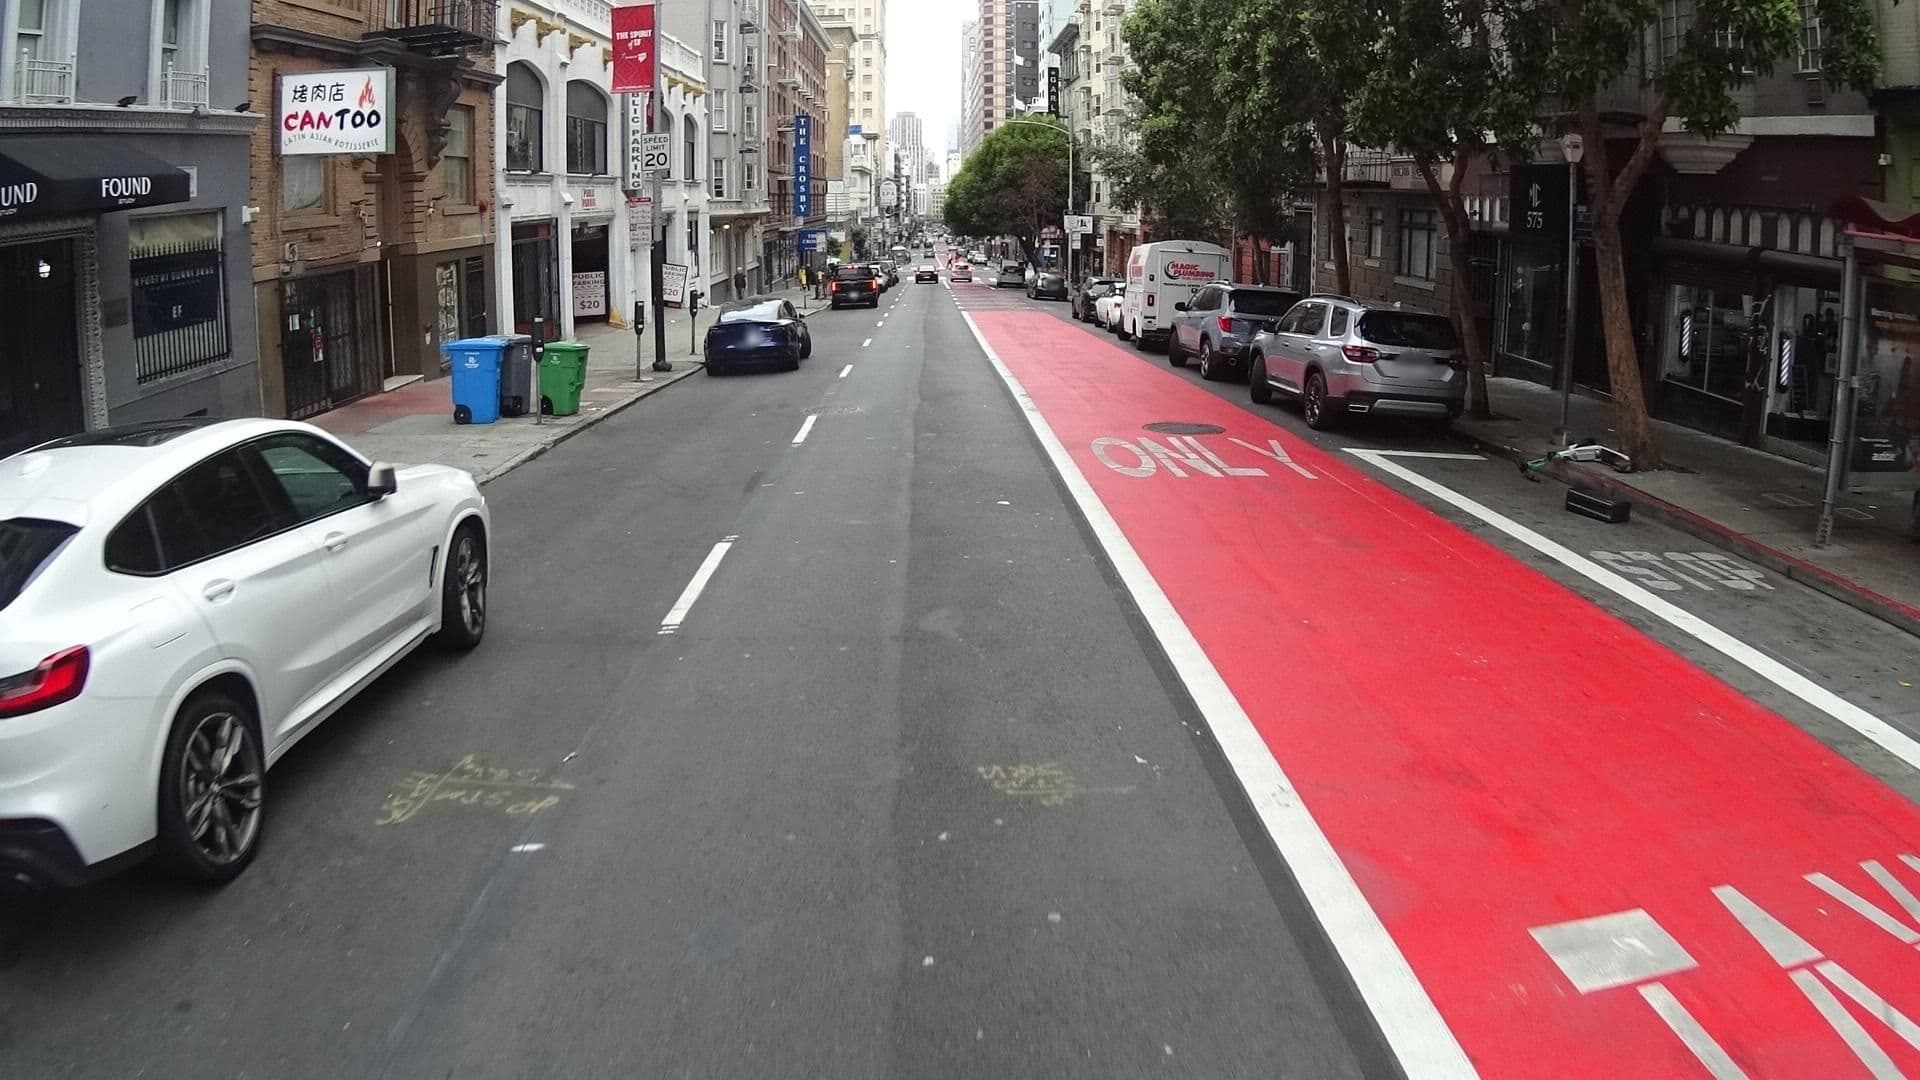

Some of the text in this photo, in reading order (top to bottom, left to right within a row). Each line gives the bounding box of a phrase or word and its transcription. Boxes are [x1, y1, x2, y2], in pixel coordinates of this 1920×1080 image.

[616, 29, 652, 40] THE SPIRIT
[291, 82, 345, 103] 烤肉店
[284, 108, 381, 131] CANTOO
[283, 132, 380, 151] LATIN ASIAN ROTISSERIE
[643, 136, 668, 145] SPEED
[645, 144, 665, 152] LIMIT
[631, 129, 641, 188] PARKING
[644, 152, 668, 167] 20
[101, 176, 151, 198] FOUND
[799, 155, 807, 212] CROSBY
[1526, 211, 1543, 229] 575
[1171, 263, 1199, 271] MAGIC
[1173, 269, 1215, 278] PLUMBING
[579, 300, 600, 310] $20
[1091, 437, 1318, 479] ONLY
